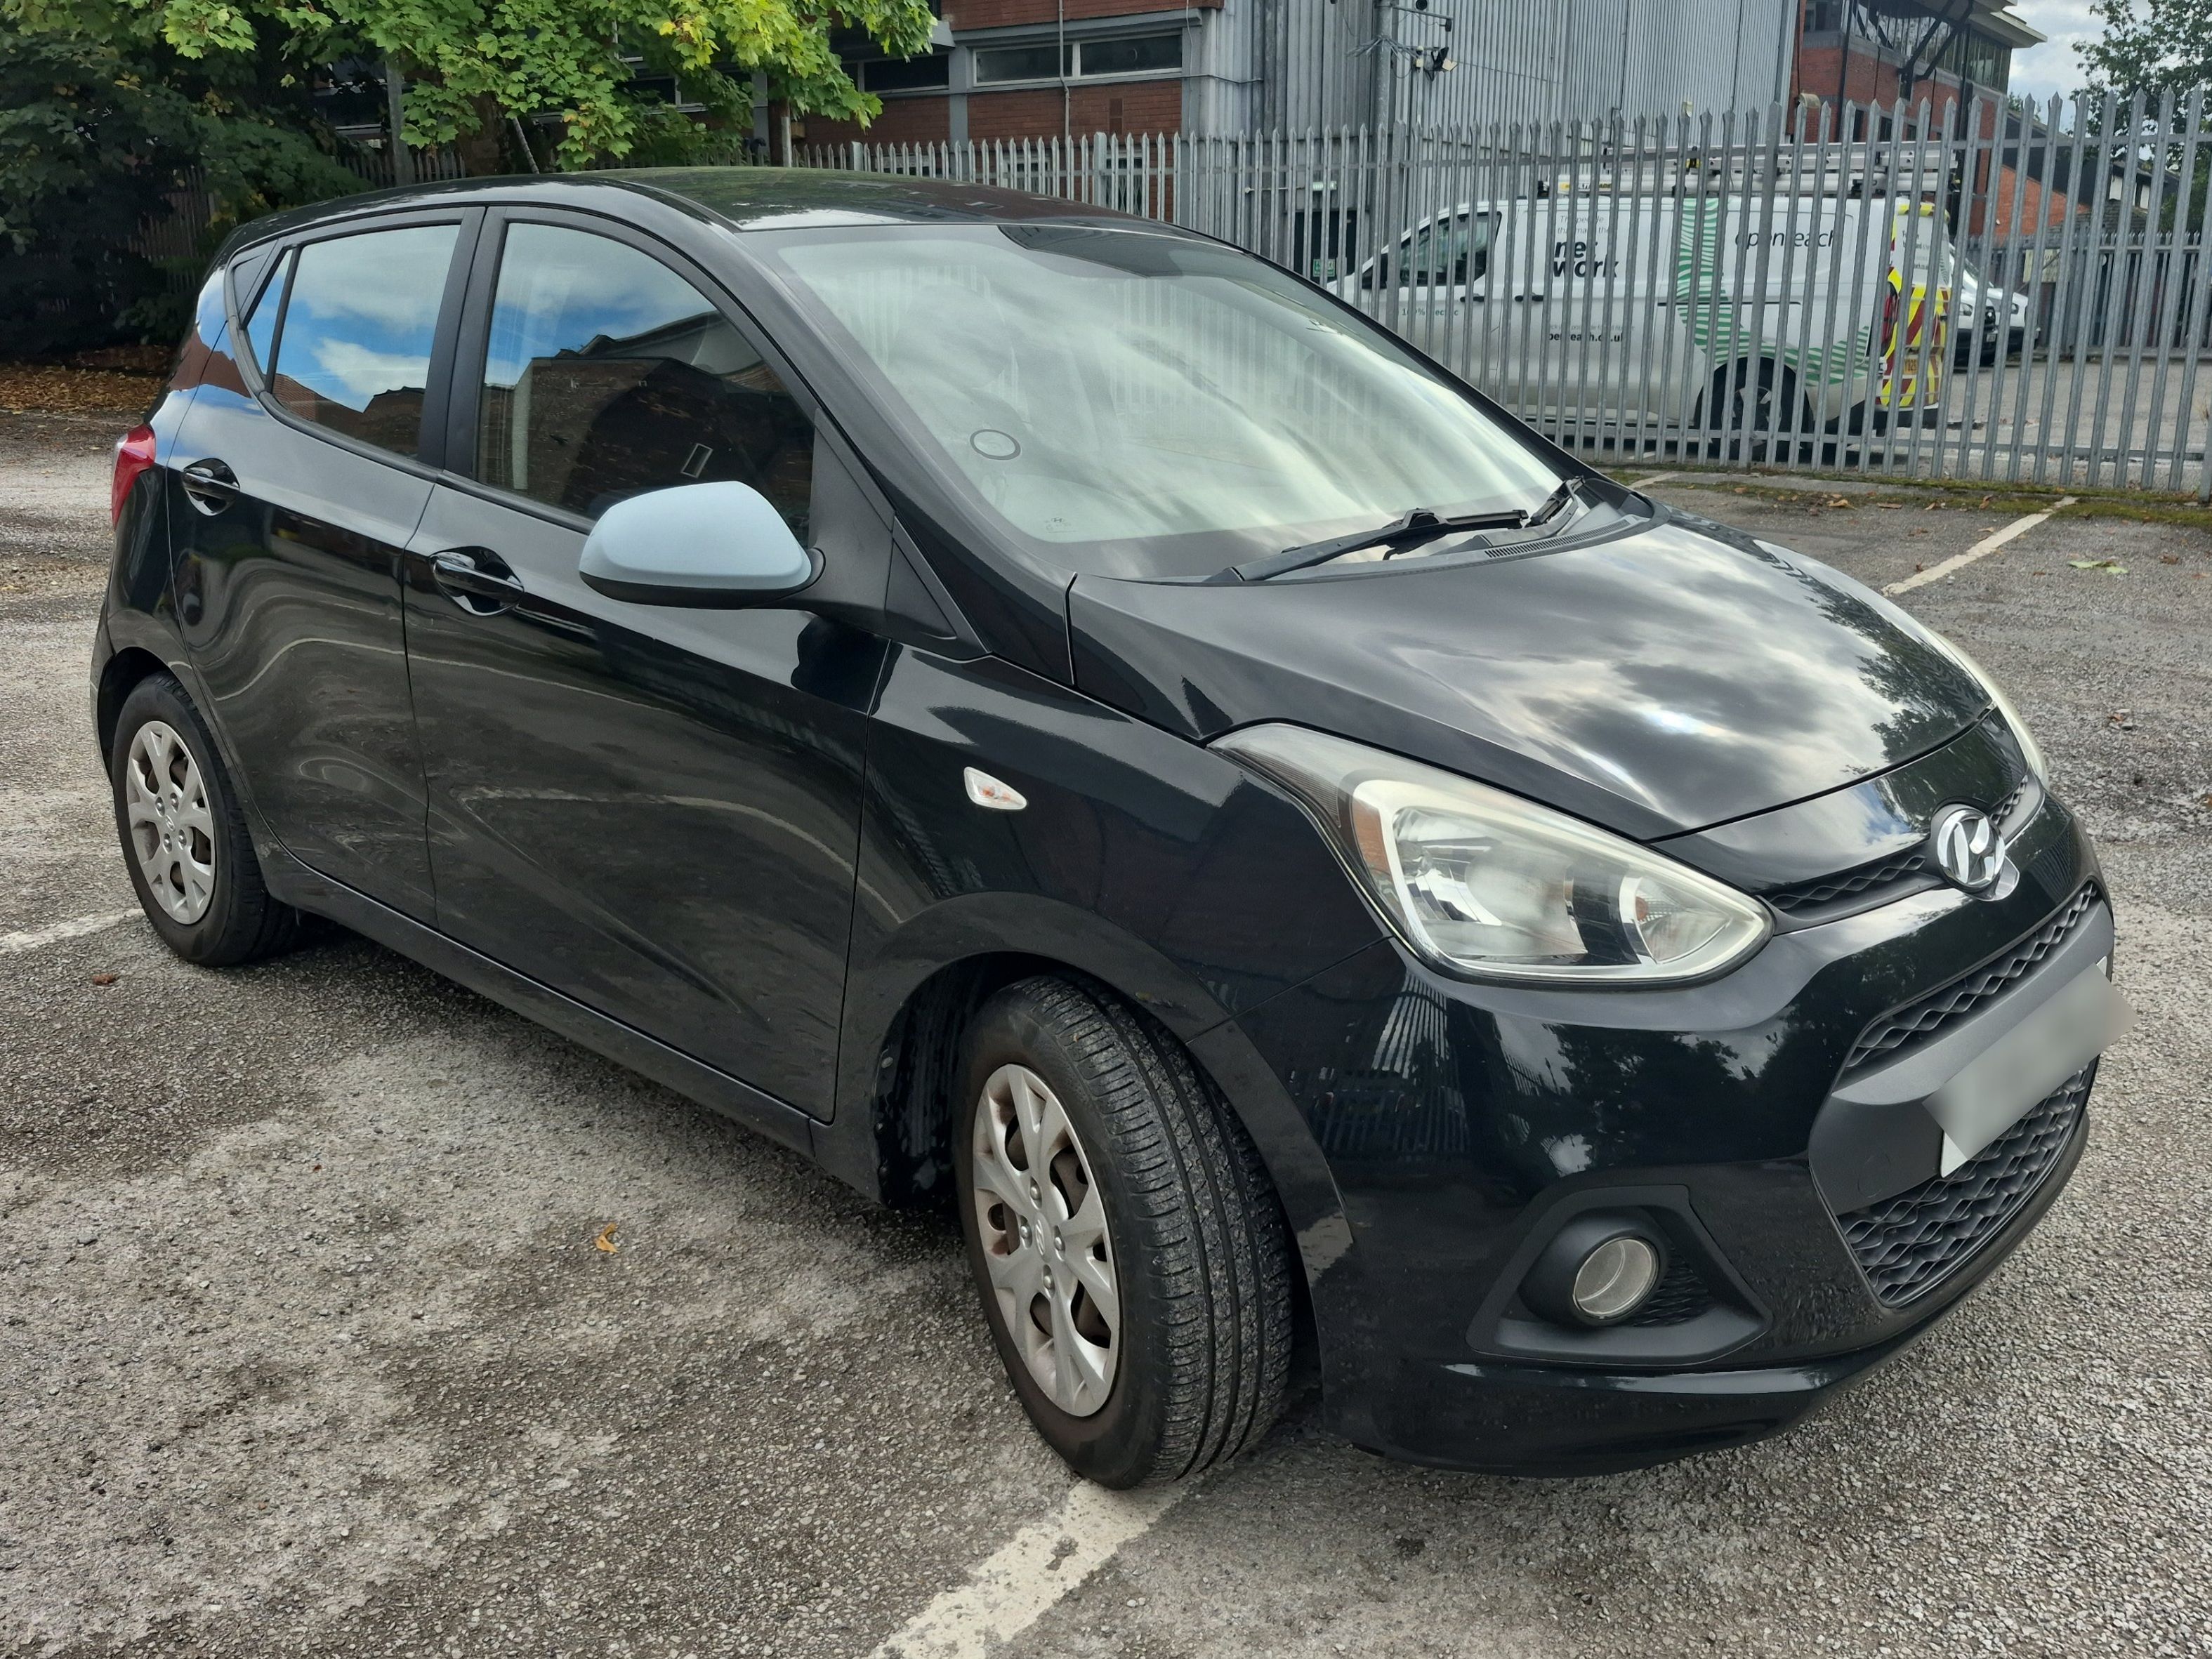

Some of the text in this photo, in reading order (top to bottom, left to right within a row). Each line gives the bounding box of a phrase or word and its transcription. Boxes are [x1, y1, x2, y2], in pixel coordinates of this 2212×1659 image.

[1735, 230, 1836, 250] pneach
[1554, 242, 1598, 258] ne
[1546, 332, 1625, 342] peeah.c.u
